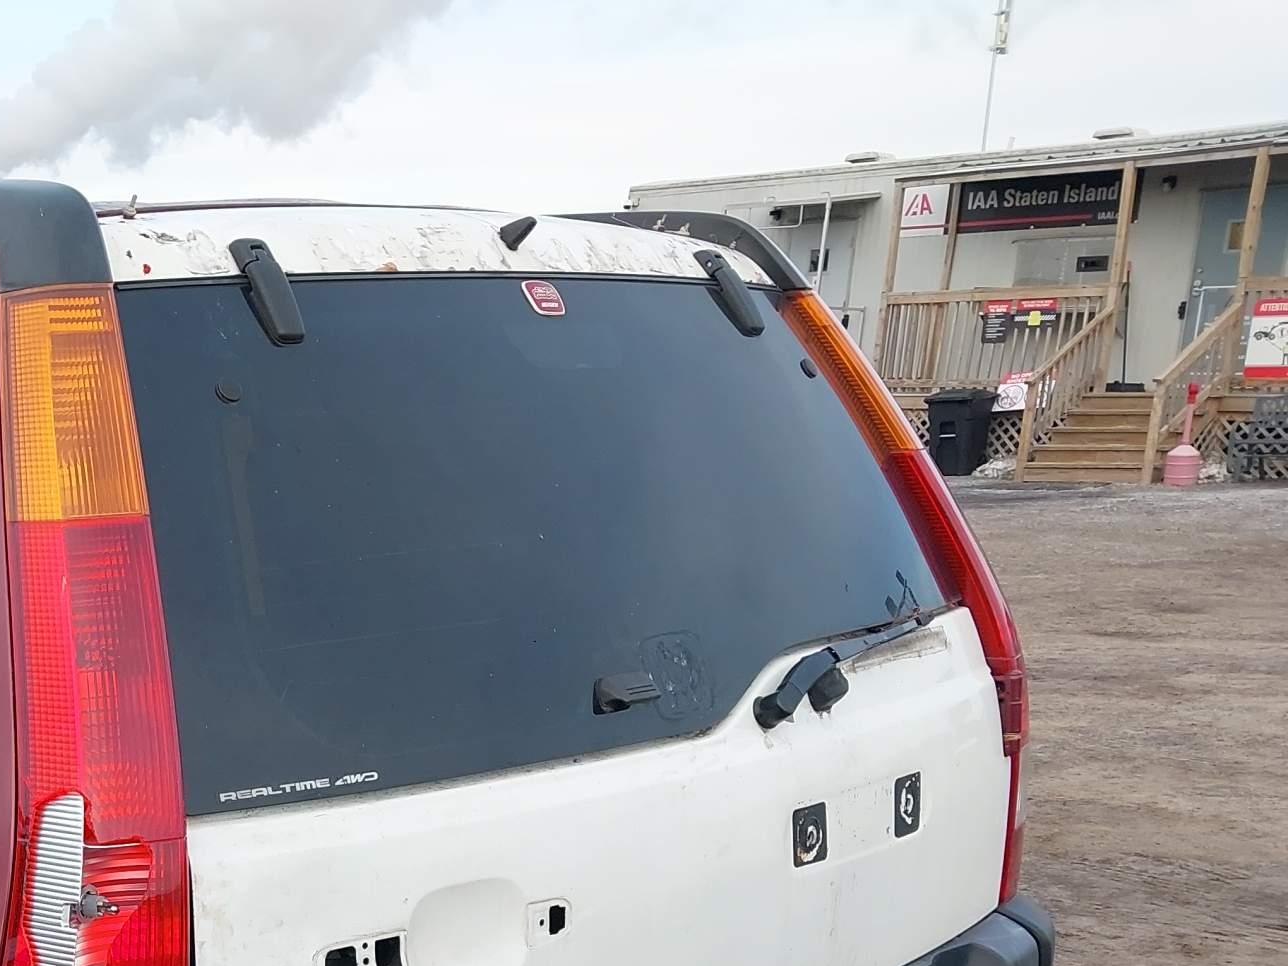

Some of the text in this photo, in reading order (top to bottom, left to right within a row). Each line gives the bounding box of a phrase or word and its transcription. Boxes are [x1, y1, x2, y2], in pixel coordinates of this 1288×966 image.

[967, 180, 1120, 210] IAA Staten Island
[219, 771, 379, 803] REALTIME 4WD
